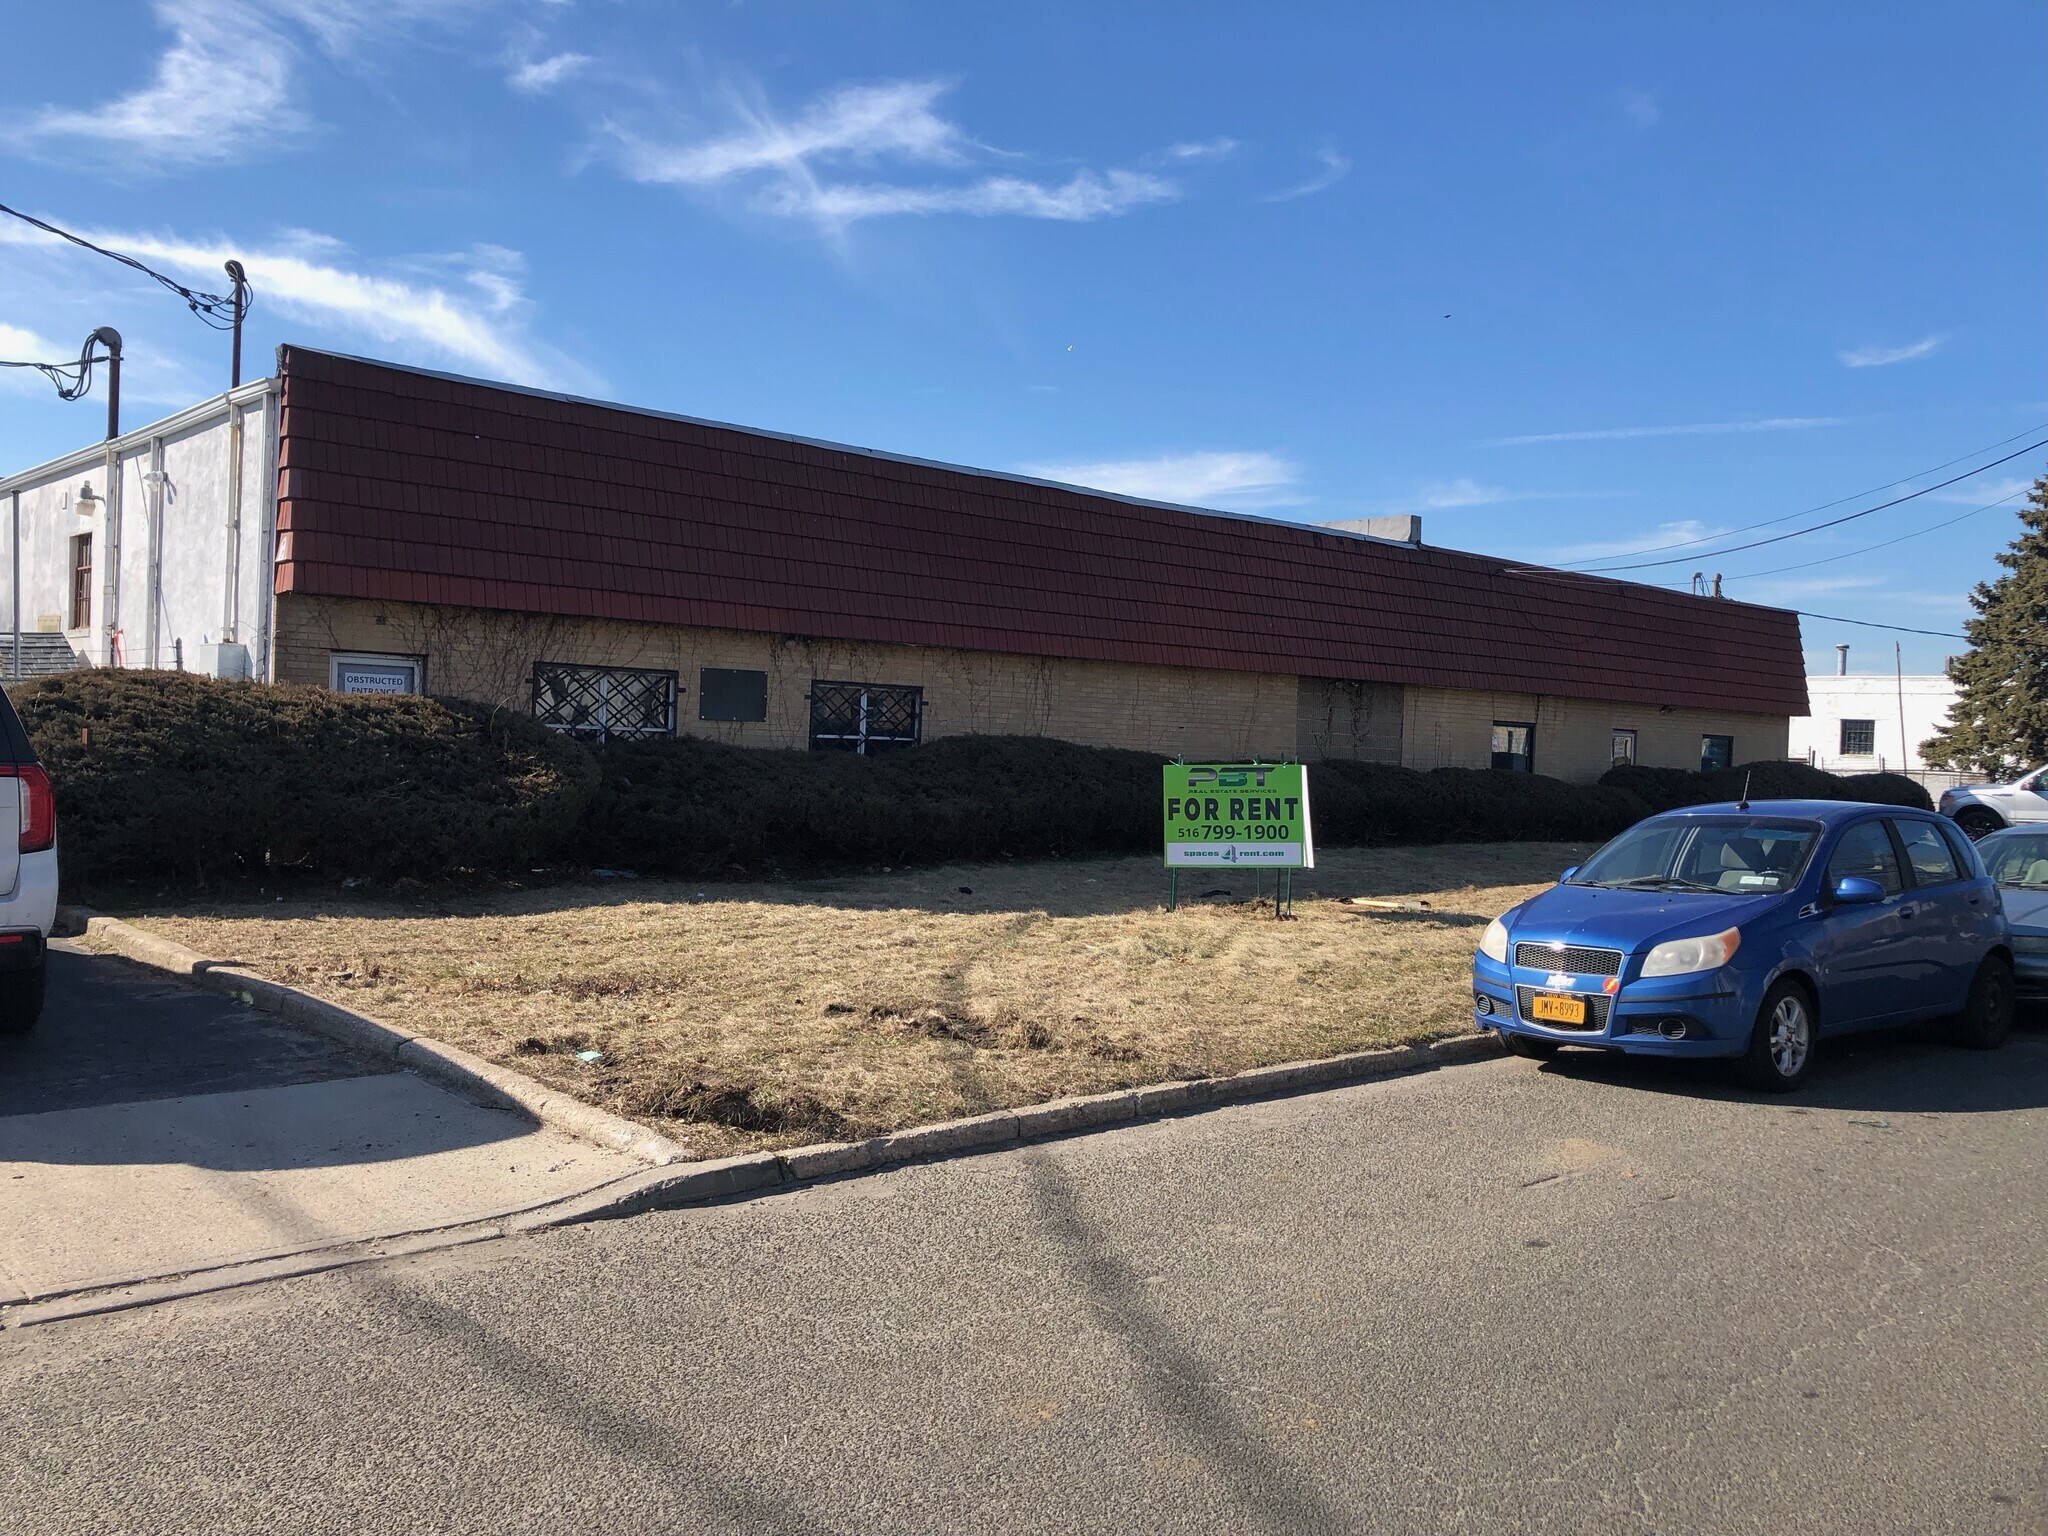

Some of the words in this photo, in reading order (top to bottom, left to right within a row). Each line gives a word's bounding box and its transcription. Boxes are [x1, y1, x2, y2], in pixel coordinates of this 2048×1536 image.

[347, 675, 403, 685] OBSTRUCTED
[1168, 798, 1219, 821] FOR
[1230, 798, 1299, 821] RENT
[1178, 828, 1200, 838] 516
[1201, 824, 1290, 840] 799-1900
[1183, 850, 1220, 858] spaces
